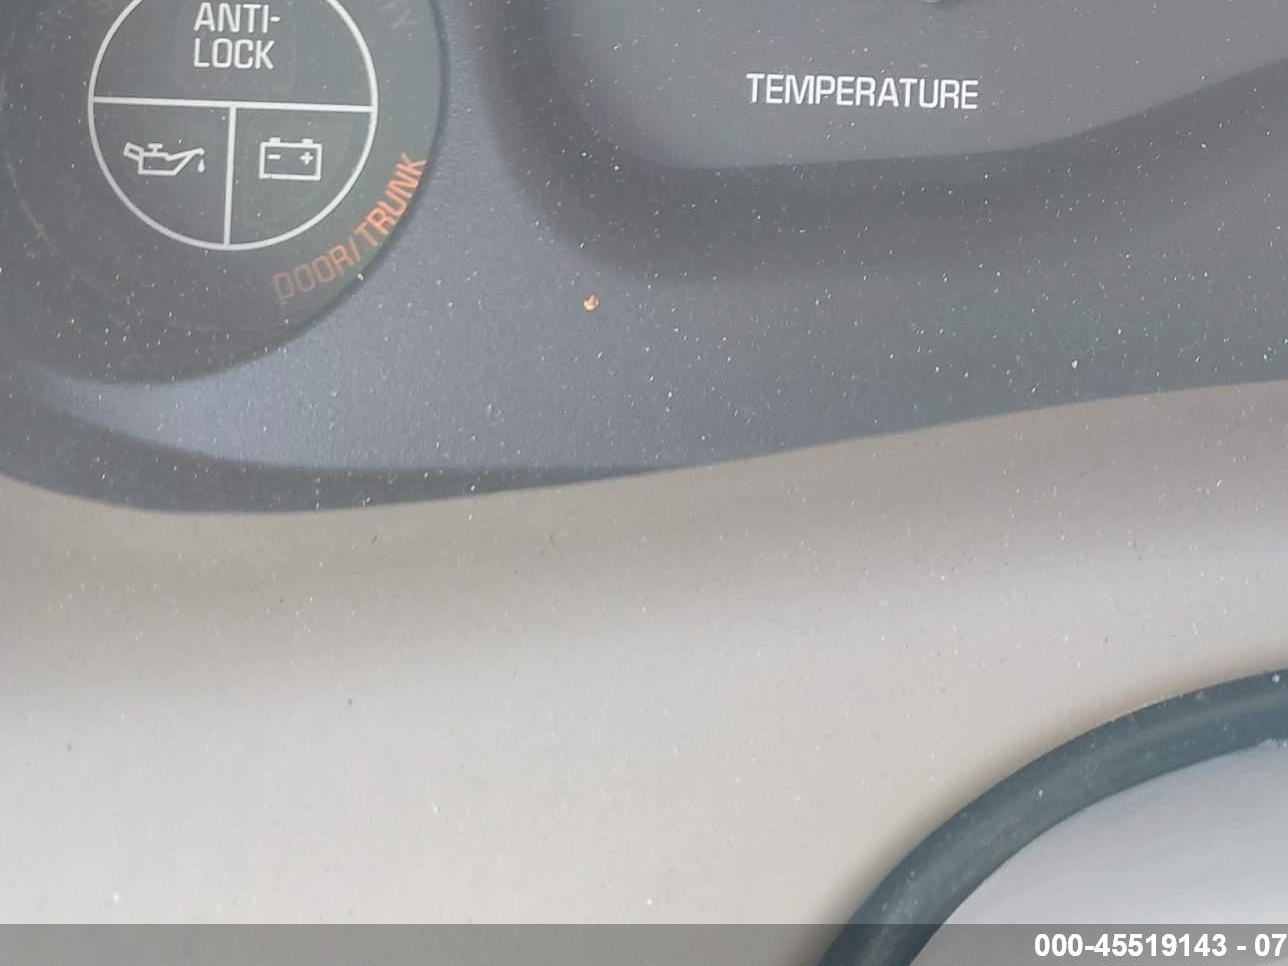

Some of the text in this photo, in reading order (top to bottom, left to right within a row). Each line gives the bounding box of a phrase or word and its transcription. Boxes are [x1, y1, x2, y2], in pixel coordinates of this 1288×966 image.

[193, 2, 281, 34] ANTI-
[194, 37, 275, 70] LOCK
[746, 73, 979, 110] TEMPERATURE
[272, 151, 427, 306] DOOR/TRUNK
